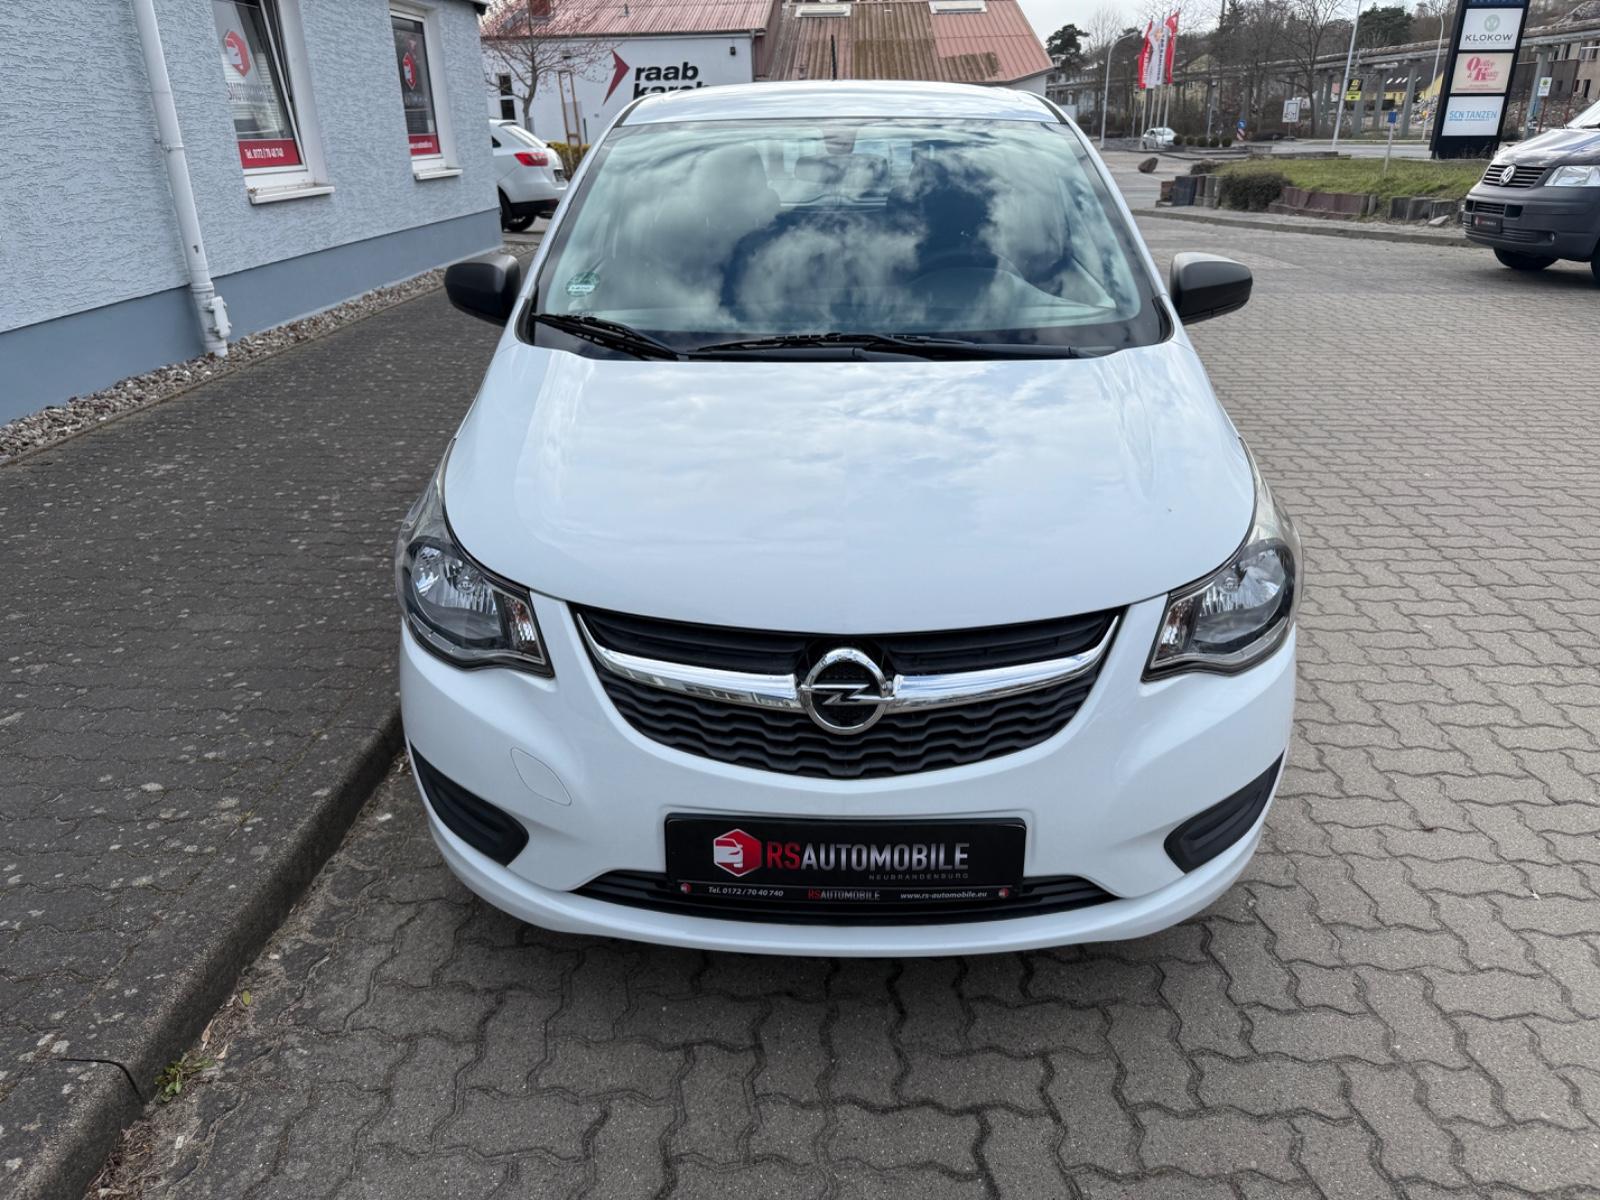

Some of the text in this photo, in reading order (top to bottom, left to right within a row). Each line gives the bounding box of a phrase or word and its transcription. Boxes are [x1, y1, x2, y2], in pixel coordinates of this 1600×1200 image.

[1465, 33, 1513, 41] KLOKOW
[634, 62, 699, 82] raab
[766, 841, 970, 872] RSAUTOMOBILE
[868, 872, 970, 882] NEUBRANDENBURG
[708, 886, 721, 895] Tel.
[723, 887, 741, 895] 0172
[900, 890, 988, 900] www.rs-automobile.eu
